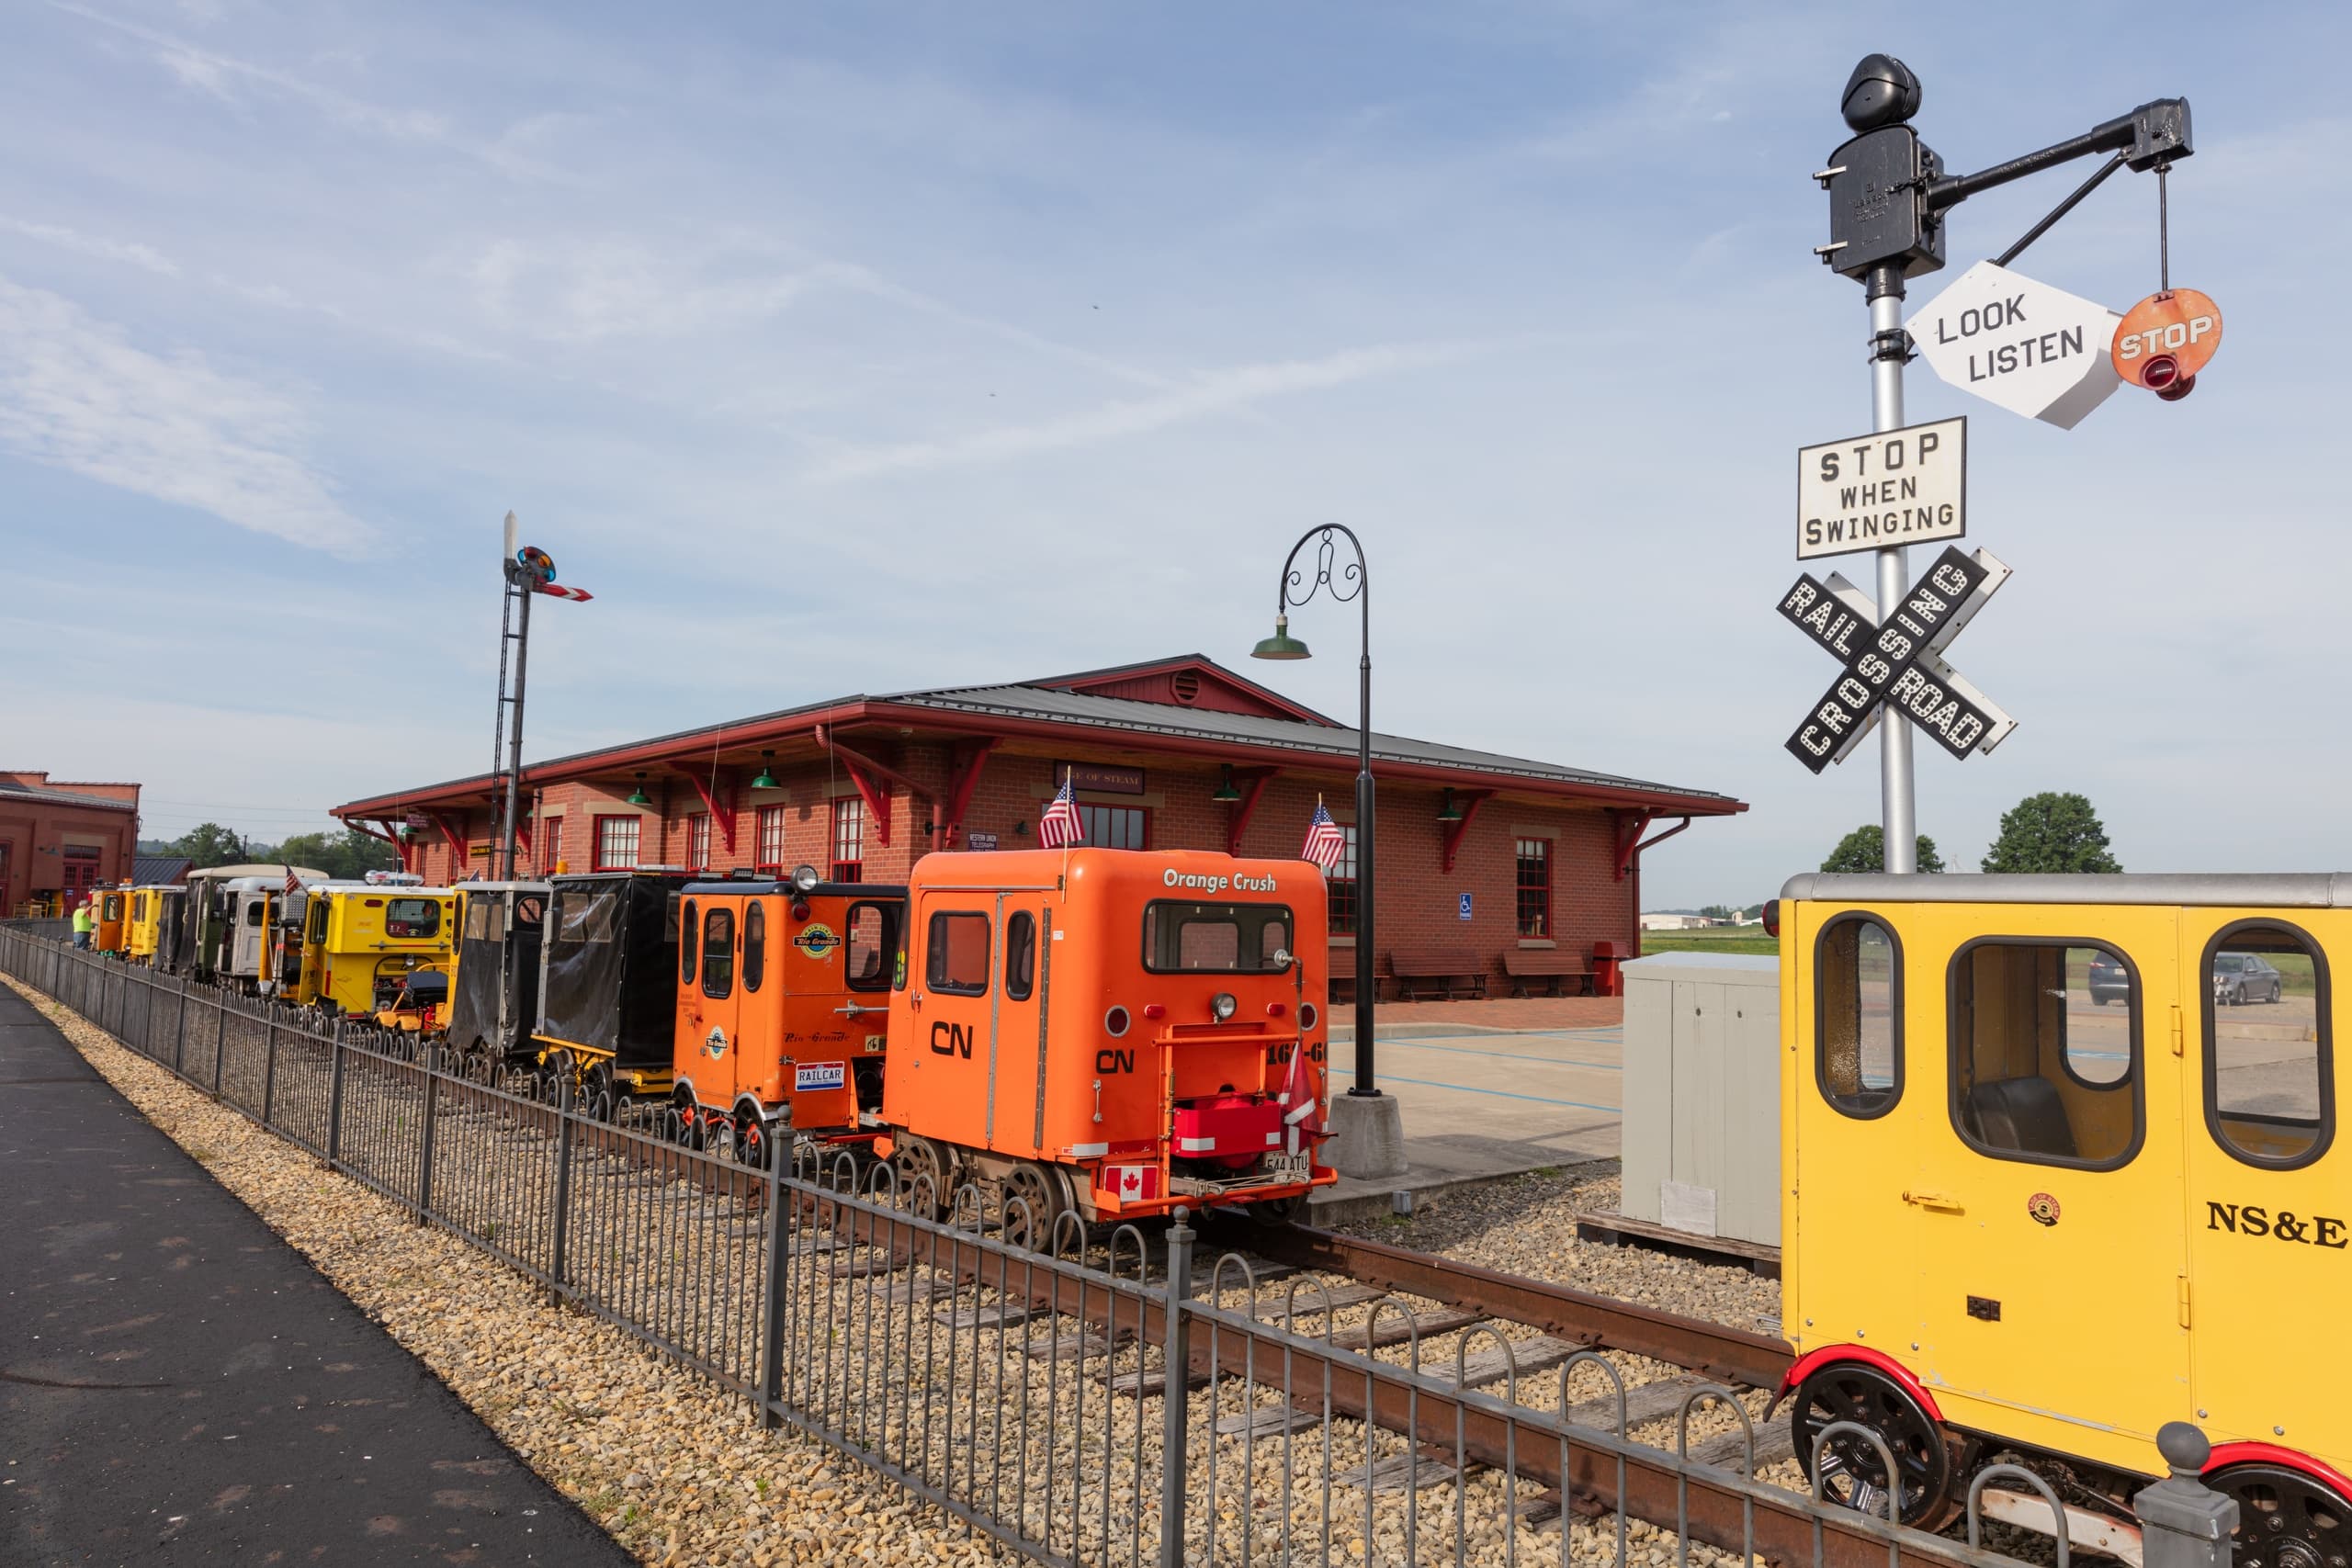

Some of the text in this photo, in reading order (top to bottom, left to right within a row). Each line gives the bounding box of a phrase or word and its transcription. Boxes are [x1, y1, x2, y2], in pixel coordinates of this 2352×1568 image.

[1938, 294, 2026, 344] LOOK
[2120, 315, 2213, 361] STOP
[1969, 325, 2084, 382] LISTEN
[1821, 432, 1939, 481] STOP
[1840, 476, 1917, 509] WHEN
[1805, 502, 1954, 545] SWINGING
[1785, 582, 1983, 749] RAIL ROAD
[1800, 562, 1968, 756] CROSSING
[1104, 774, 1139, 785] STEAM
[1163, 868, 1276, 894] Orange Crush
[812, 937, 839, 945] Grande
[785, 1032, 851, 1043] Rio Grande
[931, 1021, 973, 1060] CN
[799, 1069, 841, 1081] RAILCAR
[1096, 1049, 1135, 1074] CN
[2206, 1201, 2349, 1249] NS&E
